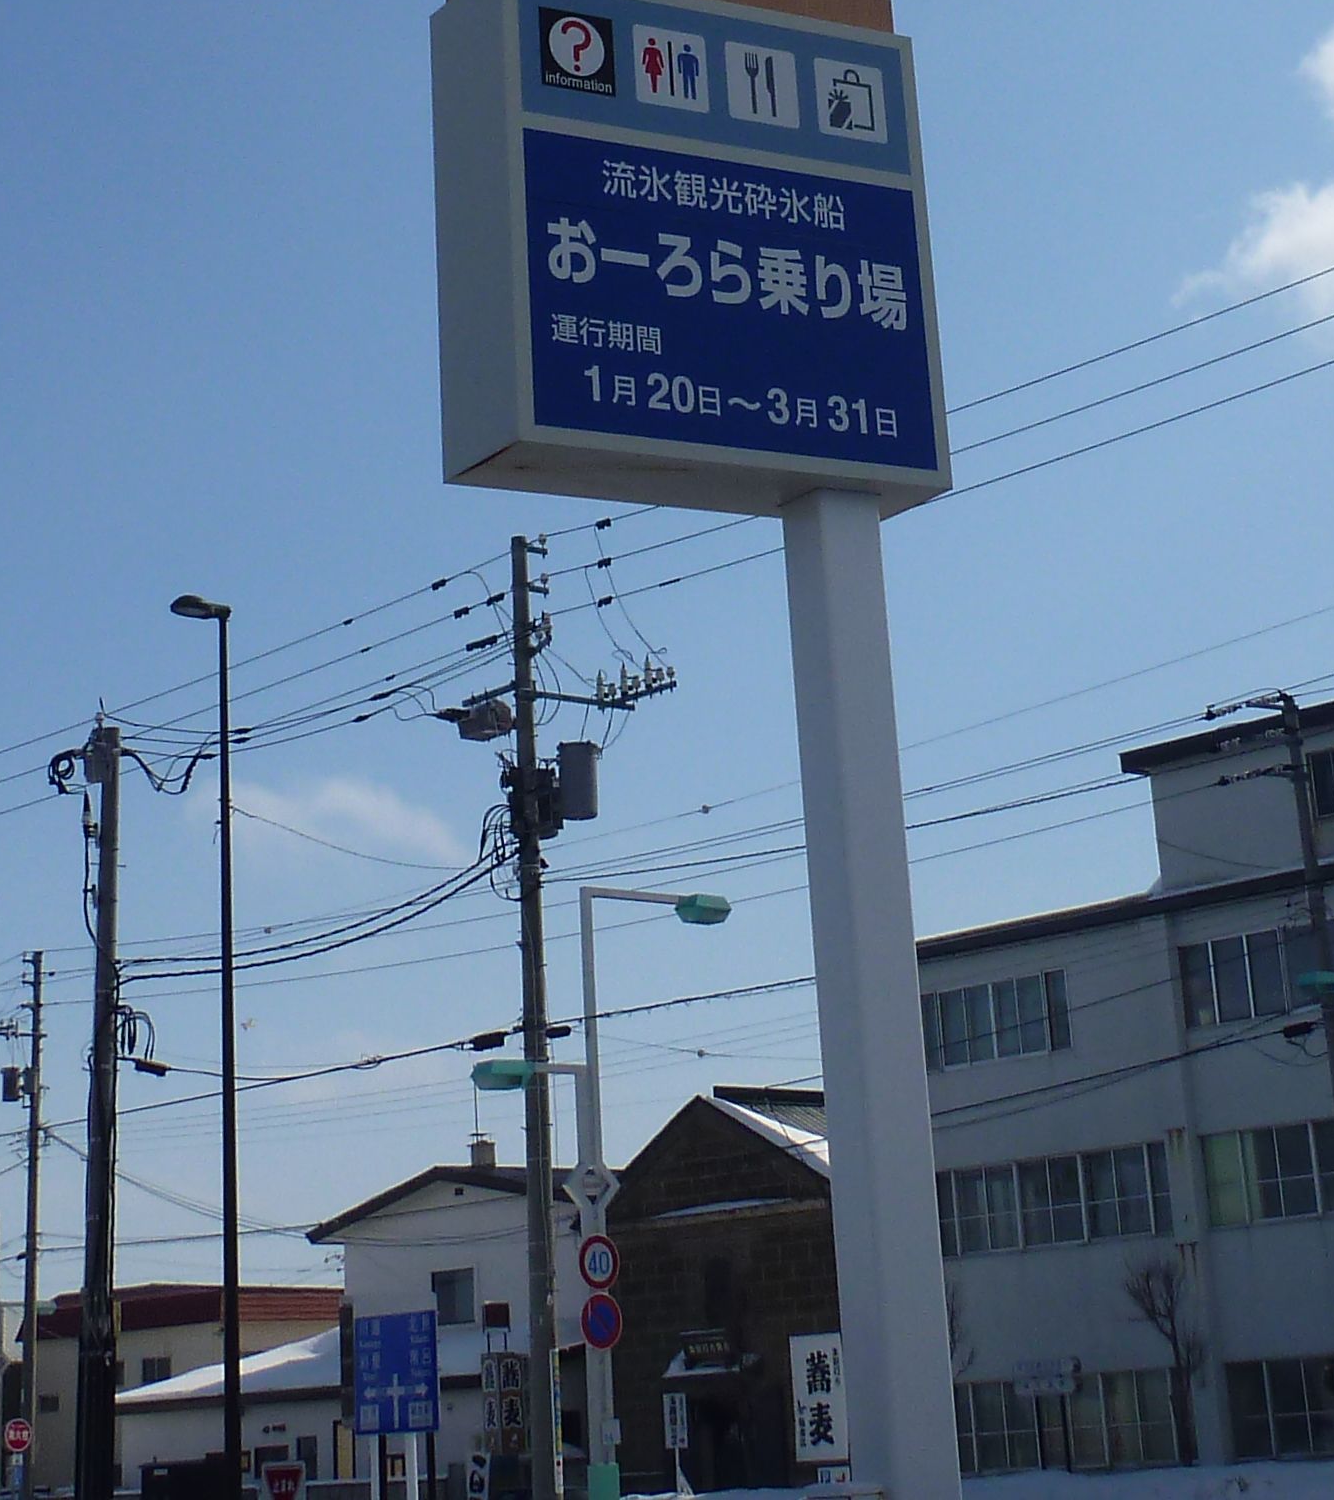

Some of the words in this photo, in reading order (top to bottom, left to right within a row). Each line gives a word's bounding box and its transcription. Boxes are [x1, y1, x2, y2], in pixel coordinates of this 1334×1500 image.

[546, 71, 612, 93] information
[602, 159, 845, 231] 流氷観光砕氷船
[547, 216, 908, 331] おーろら乗り場
[551, 313, 662, 355] 運行期間
[588, 1251, 610, 1274] 40
[806, 1350, 834, 1446] 蕎麦
